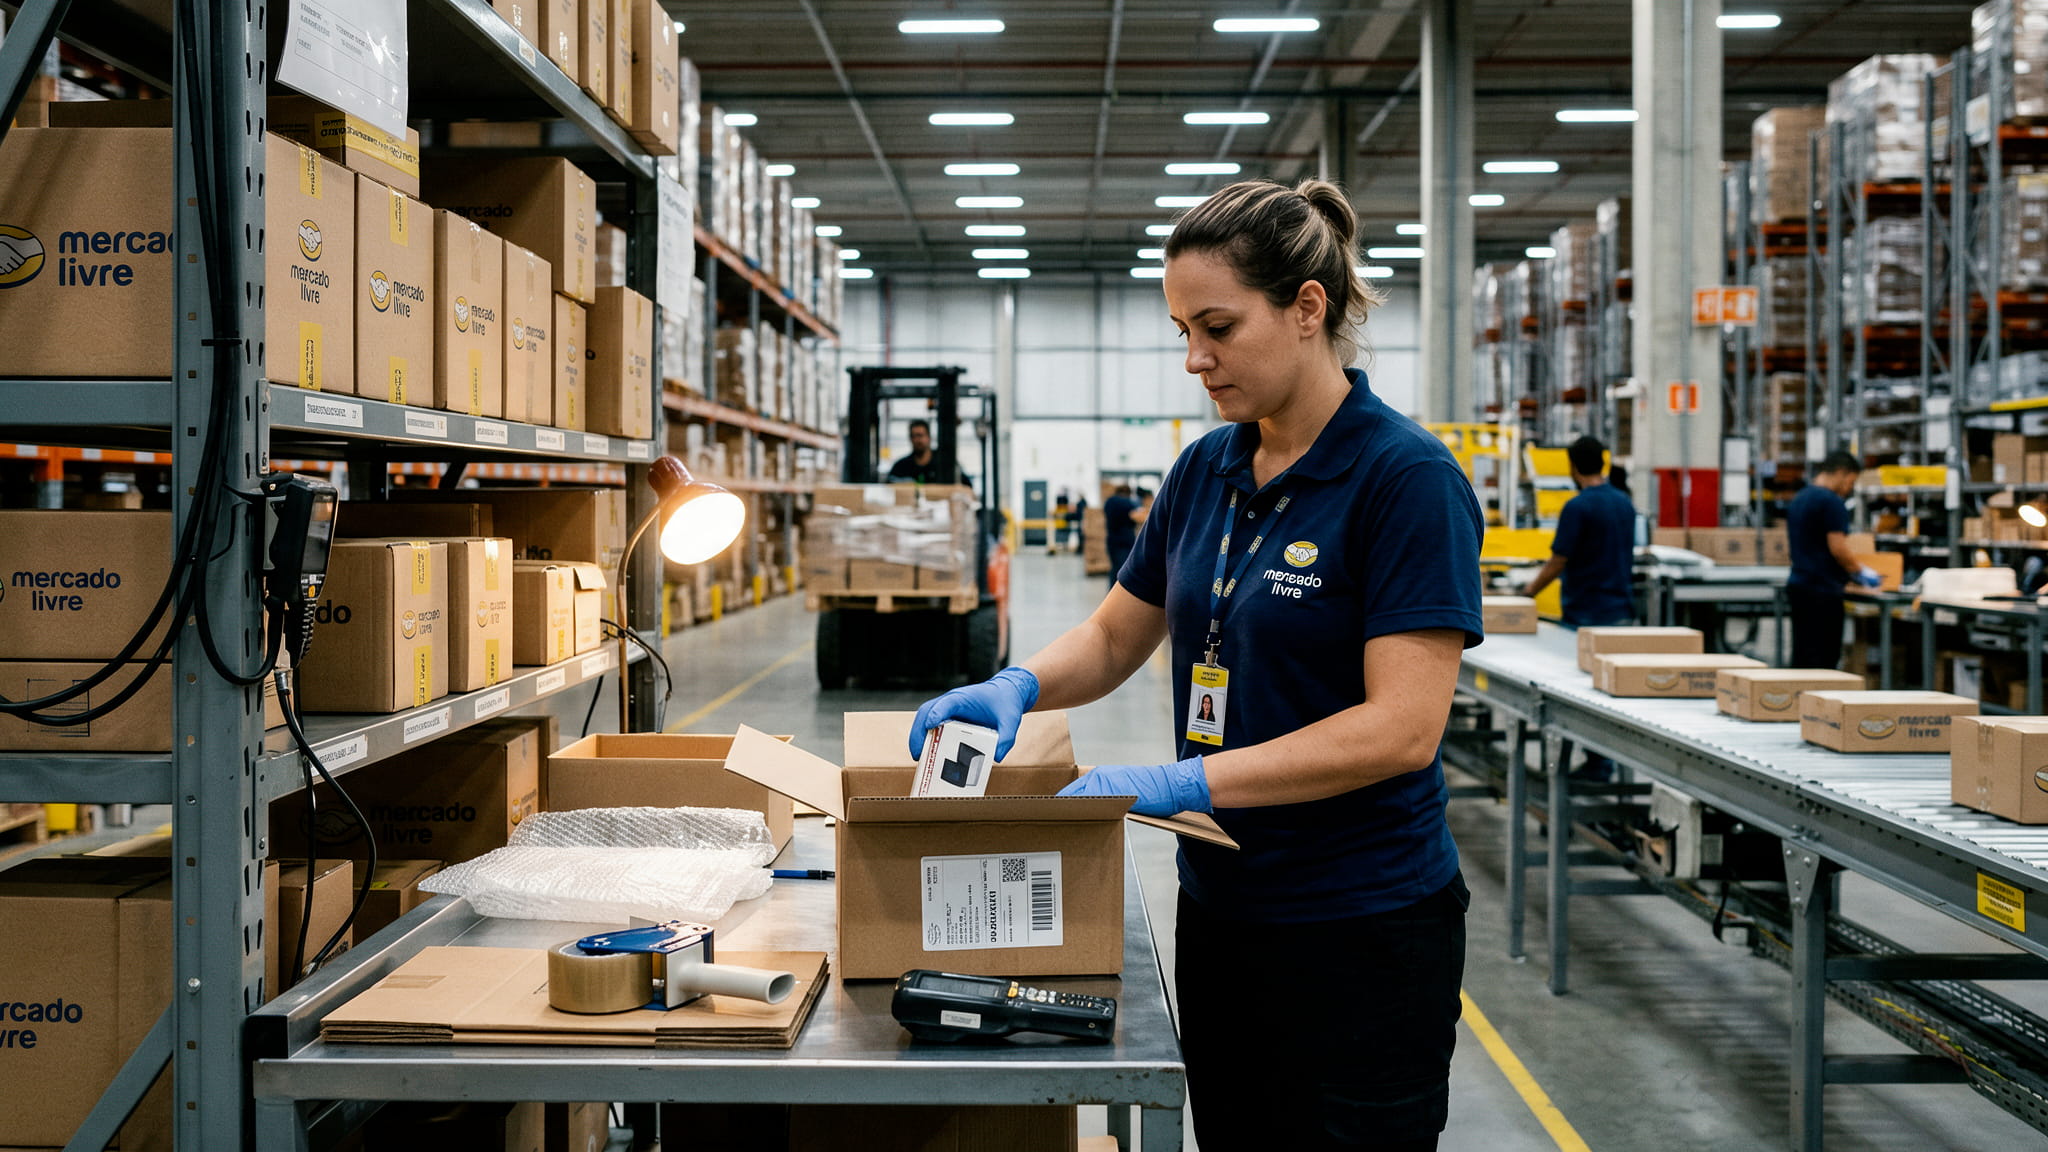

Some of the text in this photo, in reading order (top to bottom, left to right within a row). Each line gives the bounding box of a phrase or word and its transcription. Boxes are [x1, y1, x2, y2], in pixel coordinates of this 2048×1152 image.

[59, 231, 172, 254] merca
[59, 258, 133, 286] livre
[12, 568, 121, 588] mercado
[32, 591, 83, 611] livre
[370, 802, 476, 822] mercado
[383, 824, 433, 844] livre
